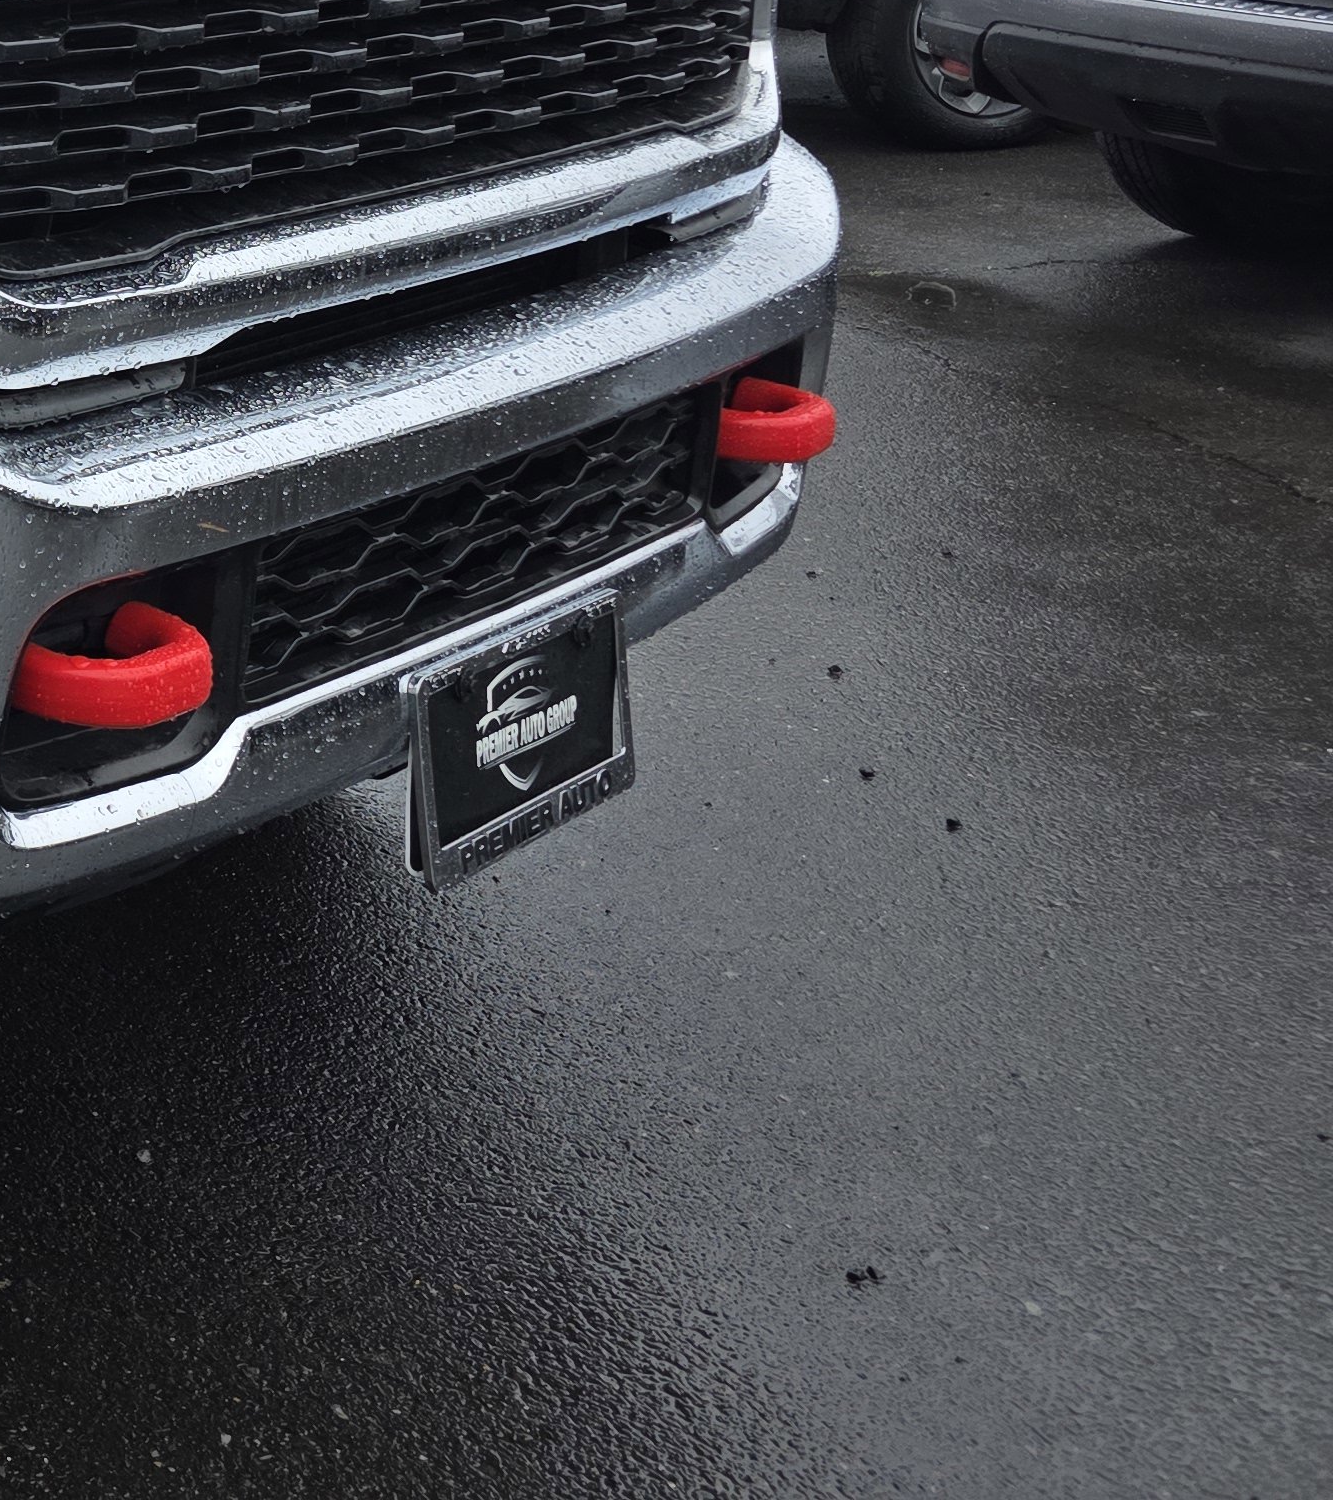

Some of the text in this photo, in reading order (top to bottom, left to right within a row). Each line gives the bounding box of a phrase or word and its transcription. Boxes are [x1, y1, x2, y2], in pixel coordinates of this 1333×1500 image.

[476, 695, 578, 768] PREMIER AUTO GROUP
[458, 768, 612, 874] PREMIER AUTO
